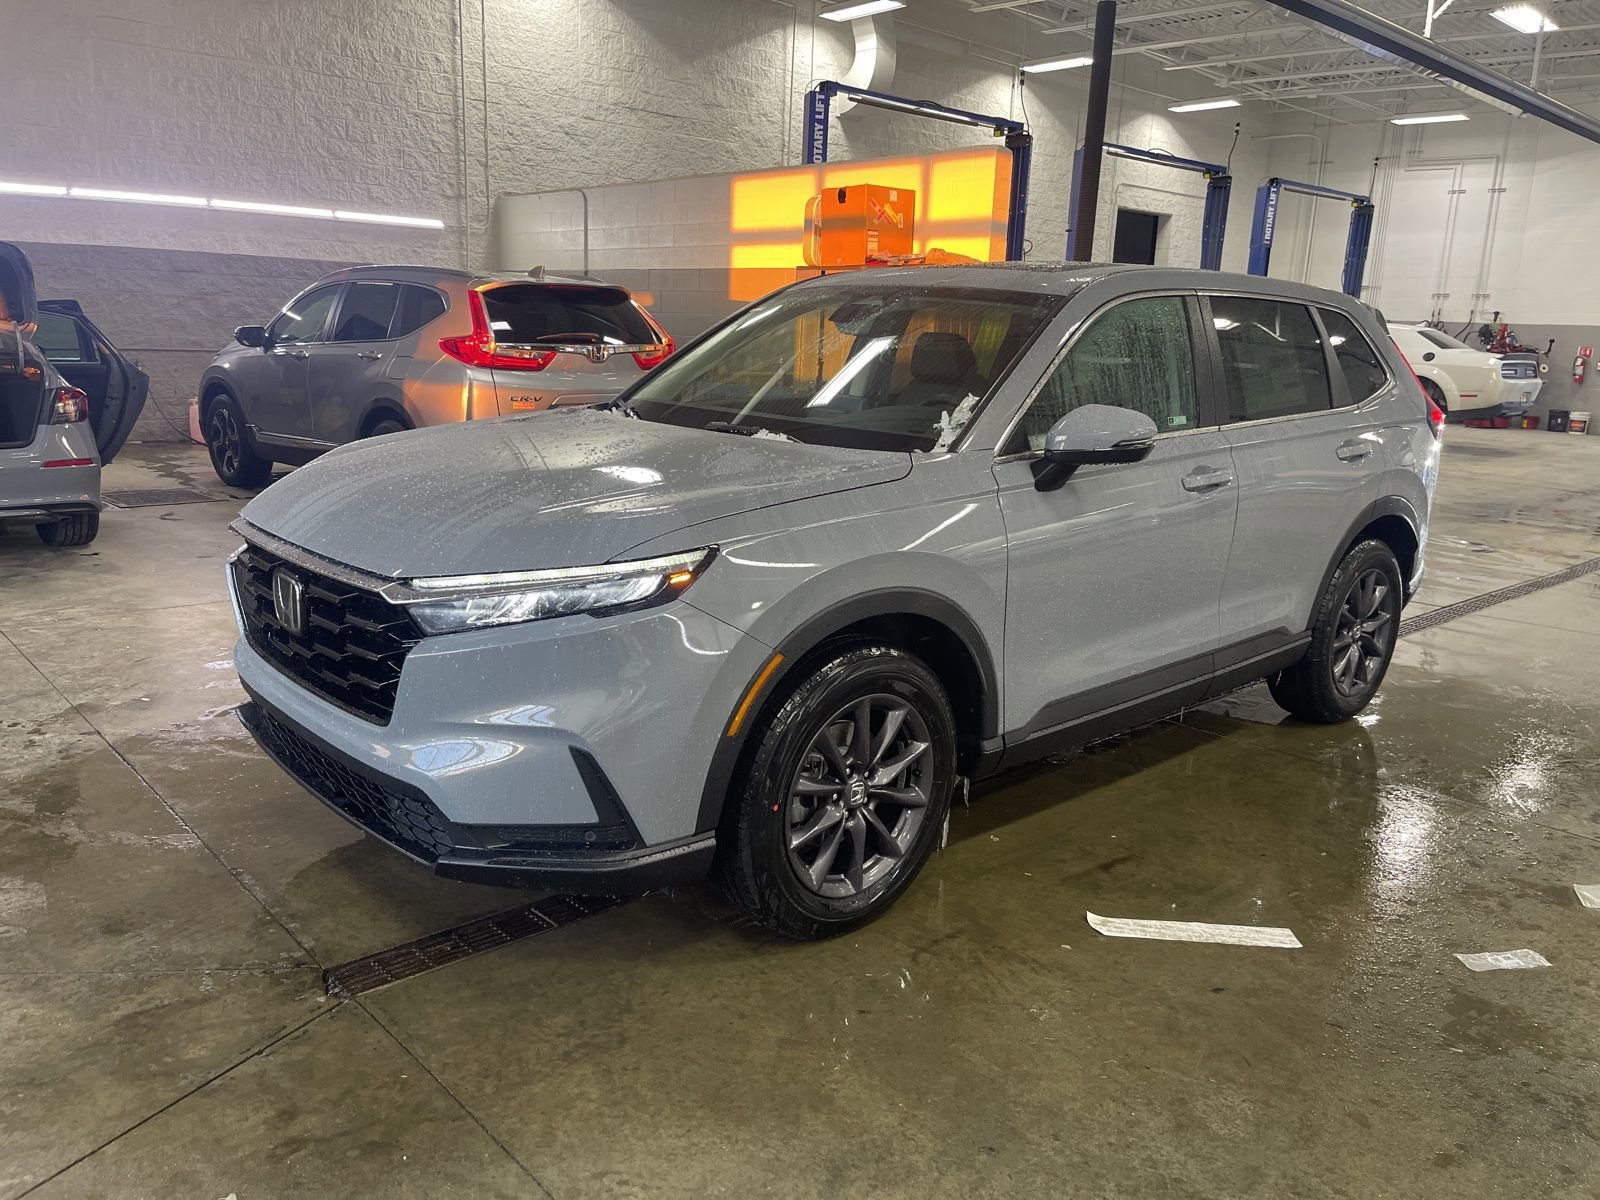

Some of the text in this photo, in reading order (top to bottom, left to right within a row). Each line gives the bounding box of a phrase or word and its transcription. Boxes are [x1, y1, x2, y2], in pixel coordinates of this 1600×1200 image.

[813, 92, 826, 164] OTARY LIFT
[1264, 186, 1278, 240] ROTARY LIFT
